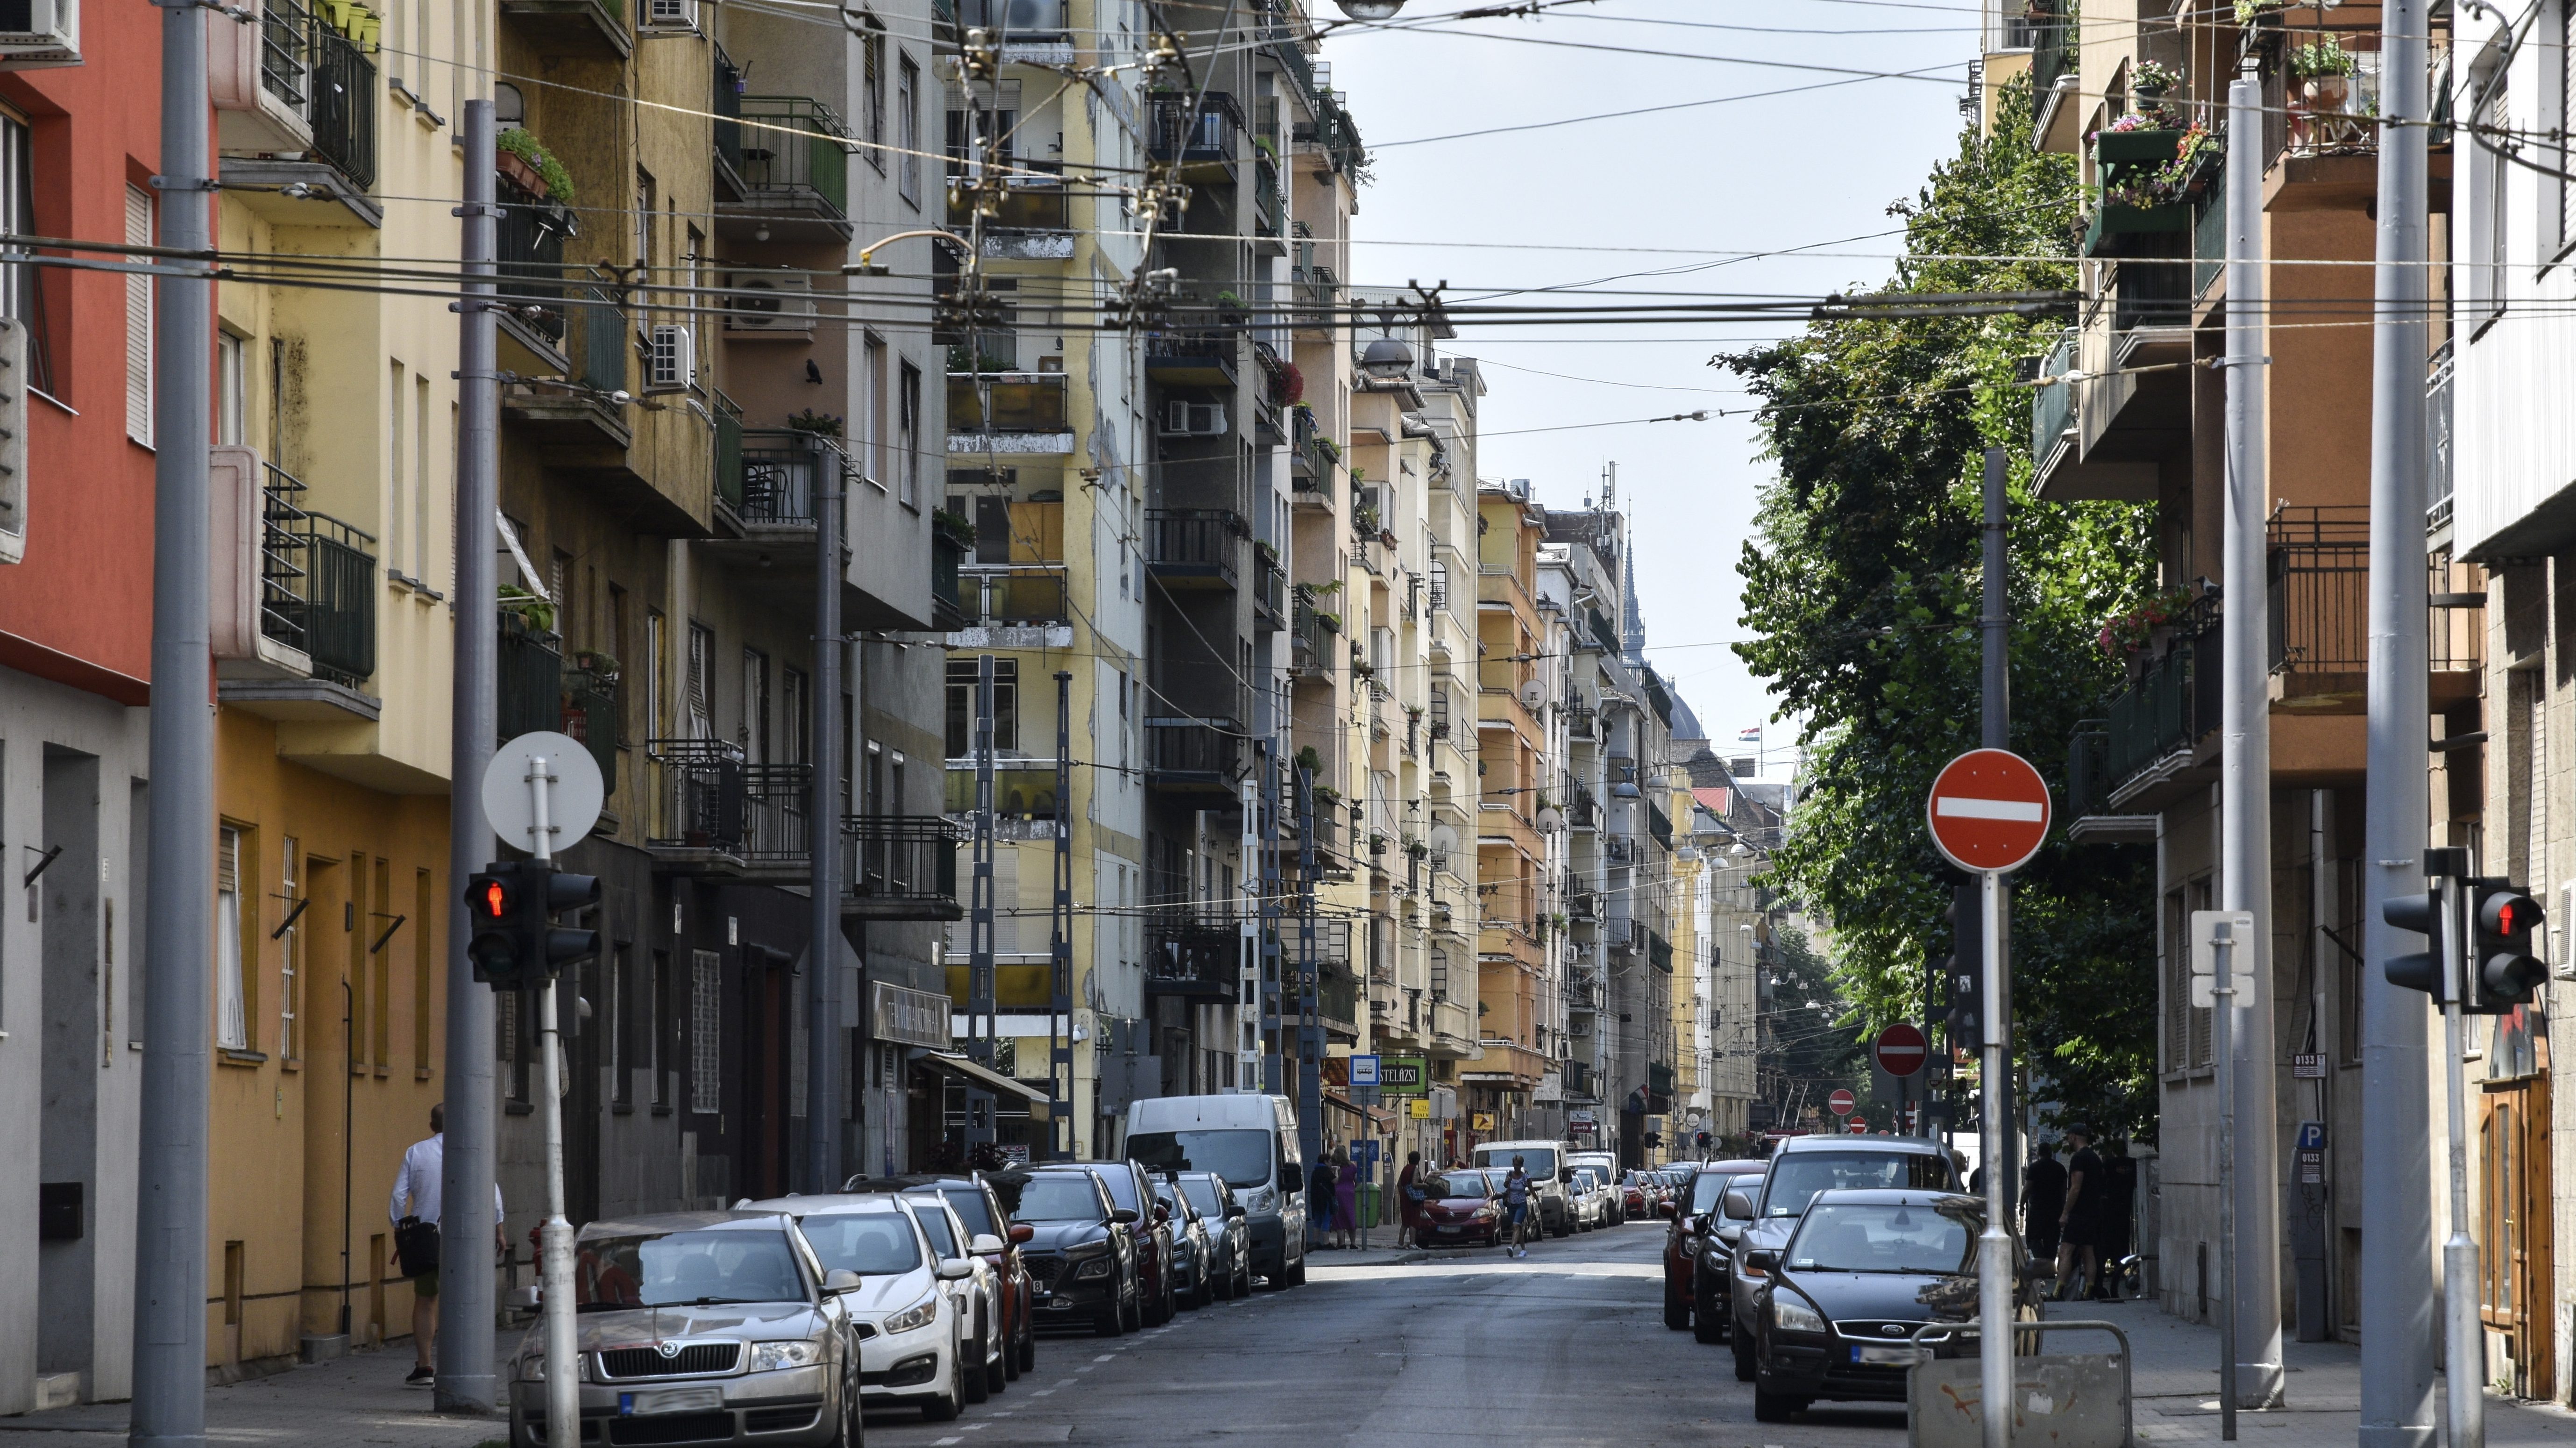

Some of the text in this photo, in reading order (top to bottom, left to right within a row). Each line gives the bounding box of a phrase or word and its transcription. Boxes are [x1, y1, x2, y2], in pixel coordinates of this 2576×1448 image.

[2295, 1055, 2314, 1065] 0133
[1380, 1068, 1416, 1082] STELÁZSI
[2308, 1126, 2321, 1146] P
[2302, 1153, 2320, 1163] 0133
